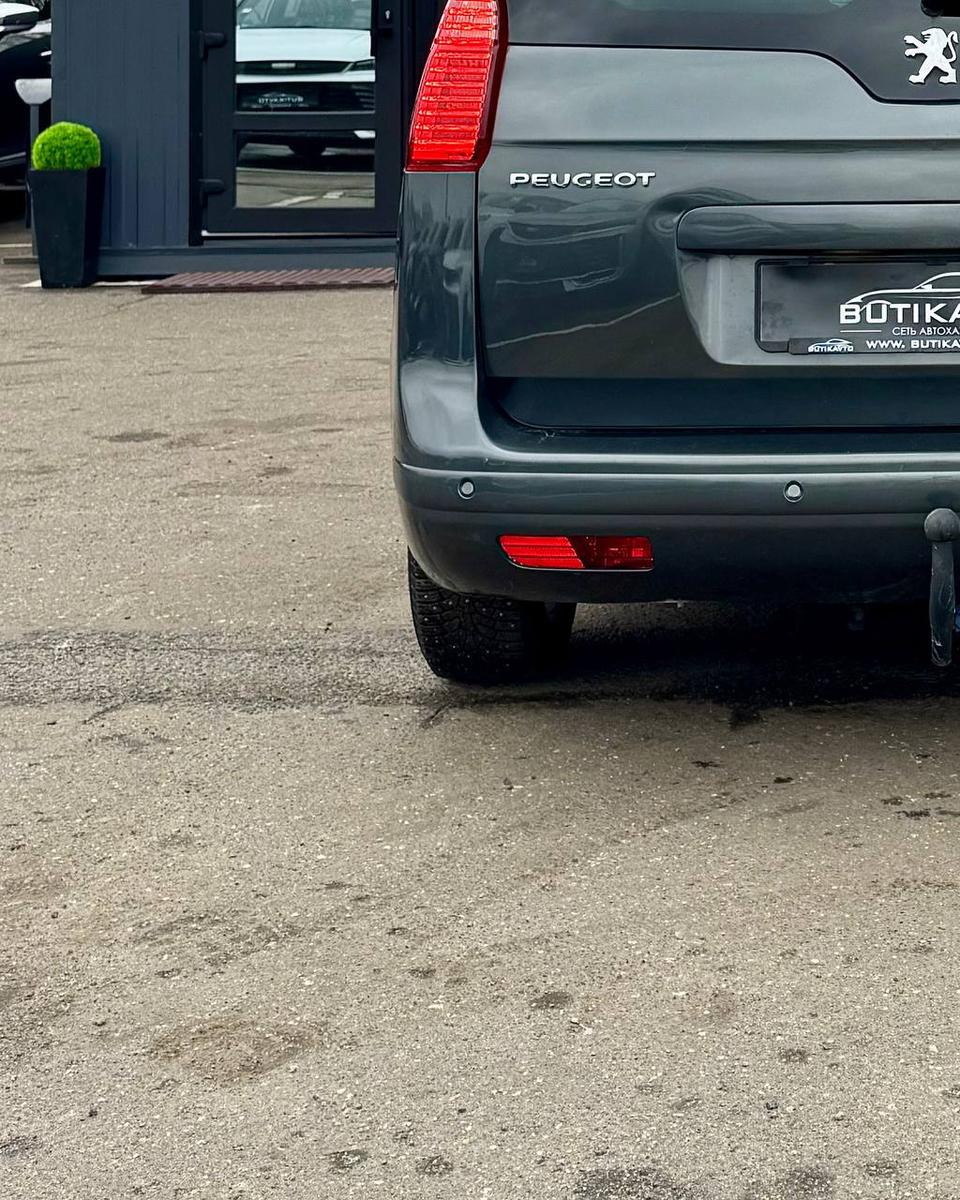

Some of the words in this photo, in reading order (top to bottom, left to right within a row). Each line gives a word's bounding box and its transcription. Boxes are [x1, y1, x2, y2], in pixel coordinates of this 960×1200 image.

[509, 171, 657, 187] PEUGEOT
[892, 326, 917, 336] СЕТЬ
[807, 344, 854, 353] BUTIKAVTO
[866, 339, 906, 350] WWW.
